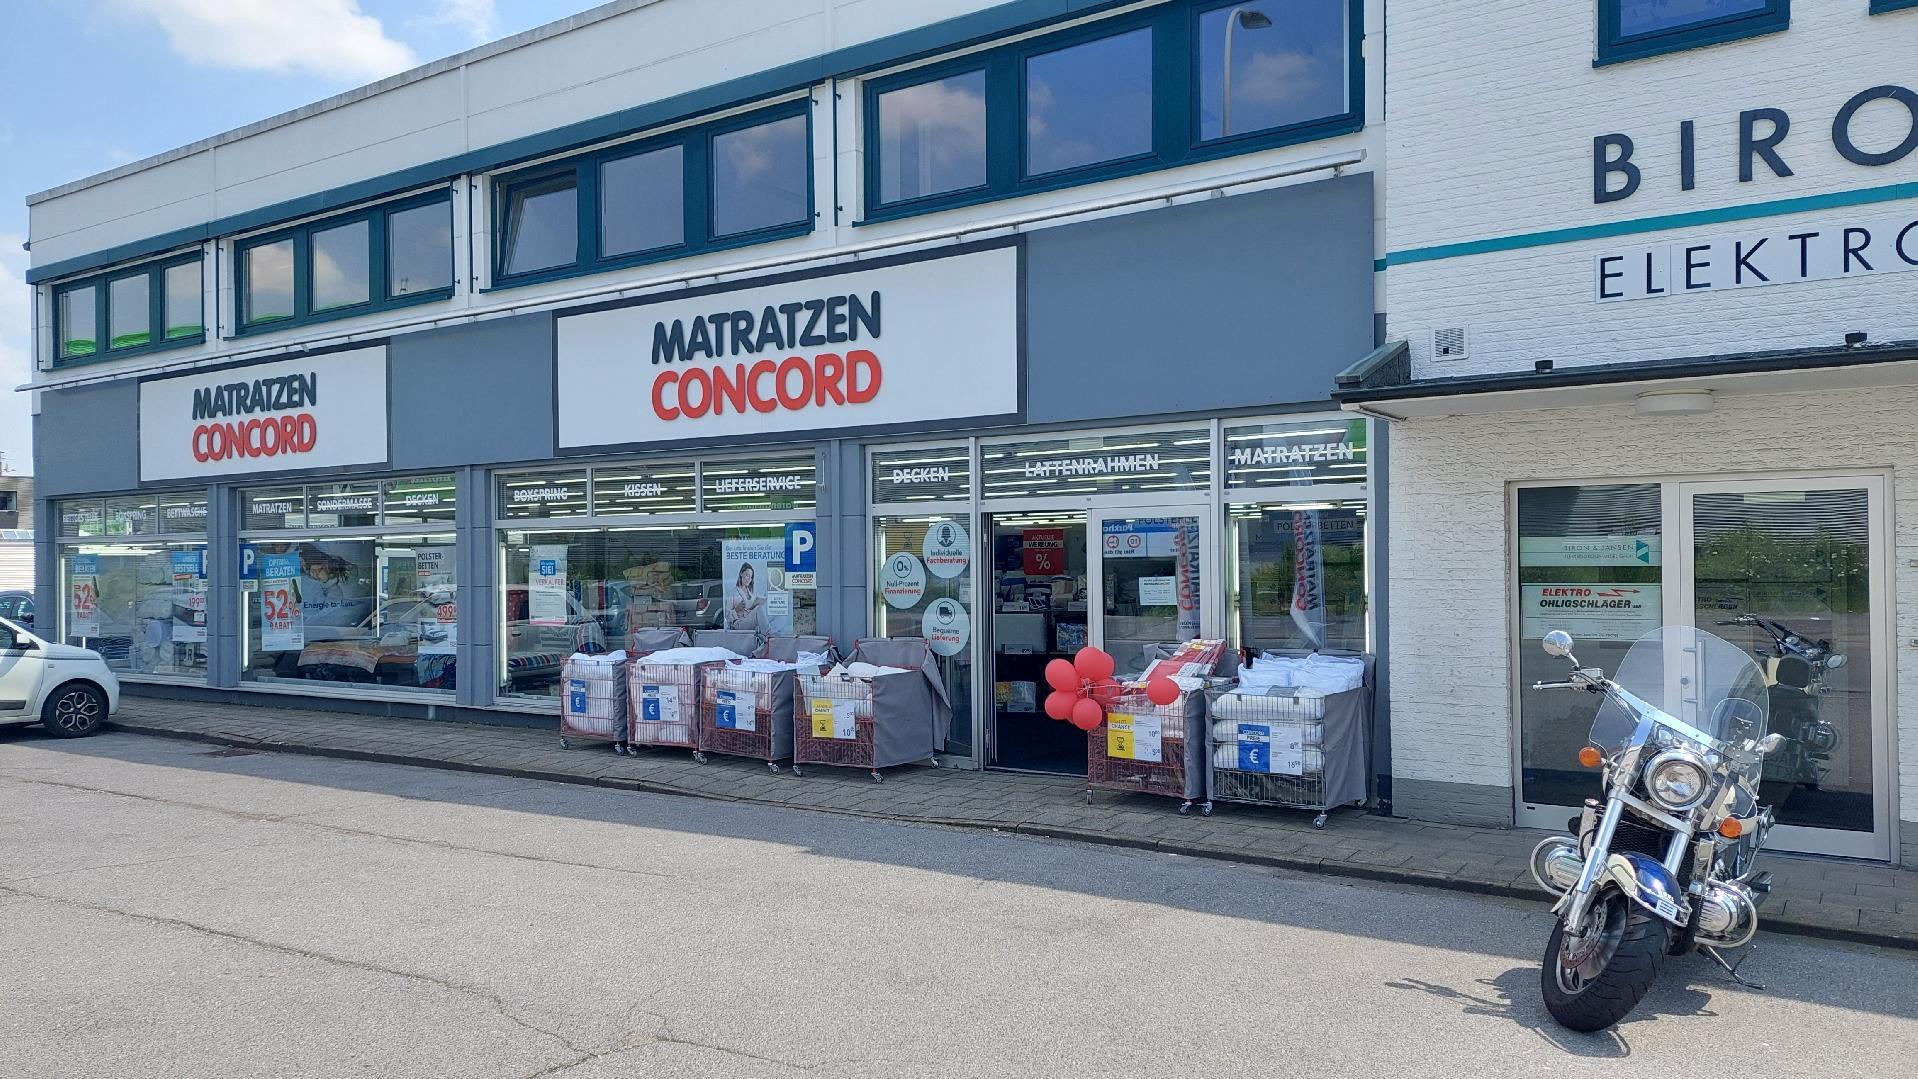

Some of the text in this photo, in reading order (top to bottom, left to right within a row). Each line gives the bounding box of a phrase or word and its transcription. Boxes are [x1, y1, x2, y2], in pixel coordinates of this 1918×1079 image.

[1593, 85, 1918, 204] BIRO
[651, 290, 881, 365] MATRATZEN
[651, 349, 882, 421] CONCORD
[192, 371, 317, 420] MATRATZEN
[192, 413, 317, 463] CONCORD
[1234, 442, 1354, 465] MATRATZEN
[1025, 453, 1159, 478] LATTENRAHMEN
[893, 466, 949, 484] DECKEN
[624, 483, 661, 497] KISSEN
[715, 475, 801, 493] LIEFERSERVICE
[406, 493, 439, 506] DECKEN
[513, 487, 569, 502] BOXSPRING
[252, 502, 292, 514] MATRATZEN
[316, 498, 373, 512] SONDERMASSE
[792, 530, 814, 564] P
[244, 549, 255, 575] P
[726, 552, 748, 560] BESTE
[926, 556, 966, 565] Fachberatung
[265, 566, 296, 577] BERATEN
[542, 566, 554, 574] SIE!
[896, 560, 909, 572] 0%
[1542, 588, 1592, 597] ELEKTRO
[932, 634, 960, 644] Lieferung
[1249, 748, 1259, 764] €
